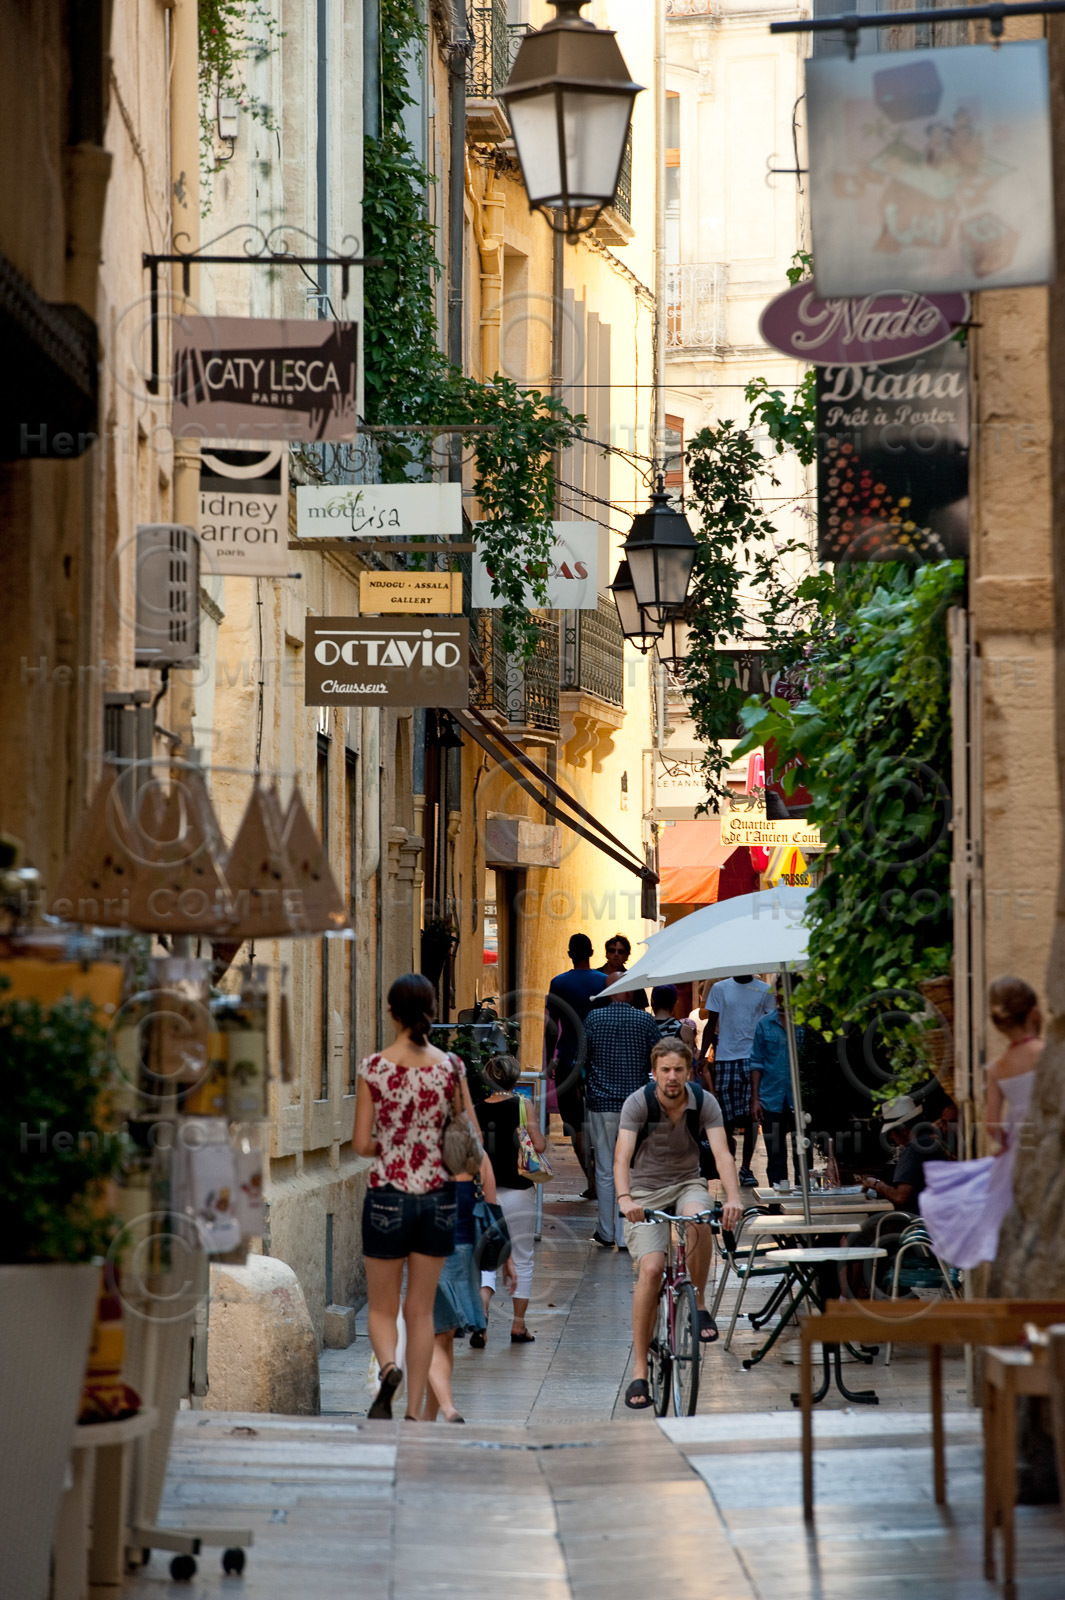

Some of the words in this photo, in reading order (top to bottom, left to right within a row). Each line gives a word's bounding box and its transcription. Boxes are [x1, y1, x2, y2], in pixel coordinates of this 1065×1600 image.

[791, 290, 943, 350] Nude
[205, 357, 265, 390] CATY
[270, 359, 341, 392] LESCA
[821, 364, 963, 402] Diana
[252, 393, 295, 405] PARIS
[825, 405, 869, 427] Prêt
[873, 407, 890, 425] à
[893, 404, 956, 425] Porter
[201, 494, 278, 525] idney
[351, 490, 401, 532] Lisa
[200, 524, 278, 543] arron
[216, 549, 246, 558] paris
[369, 581, 406, 589] NDJOGU
[414, 582, 450, 590] ASSALA
[320, 679, 389, 693] Chausseur
[730, 818, 777, 830] Quartier
[729, 831, 741, 842] de
[745, 831, 788, 843] l'Ancien
[792, 832, 821, 843] Cour
[780, 873, 810, 886] PRESSE
